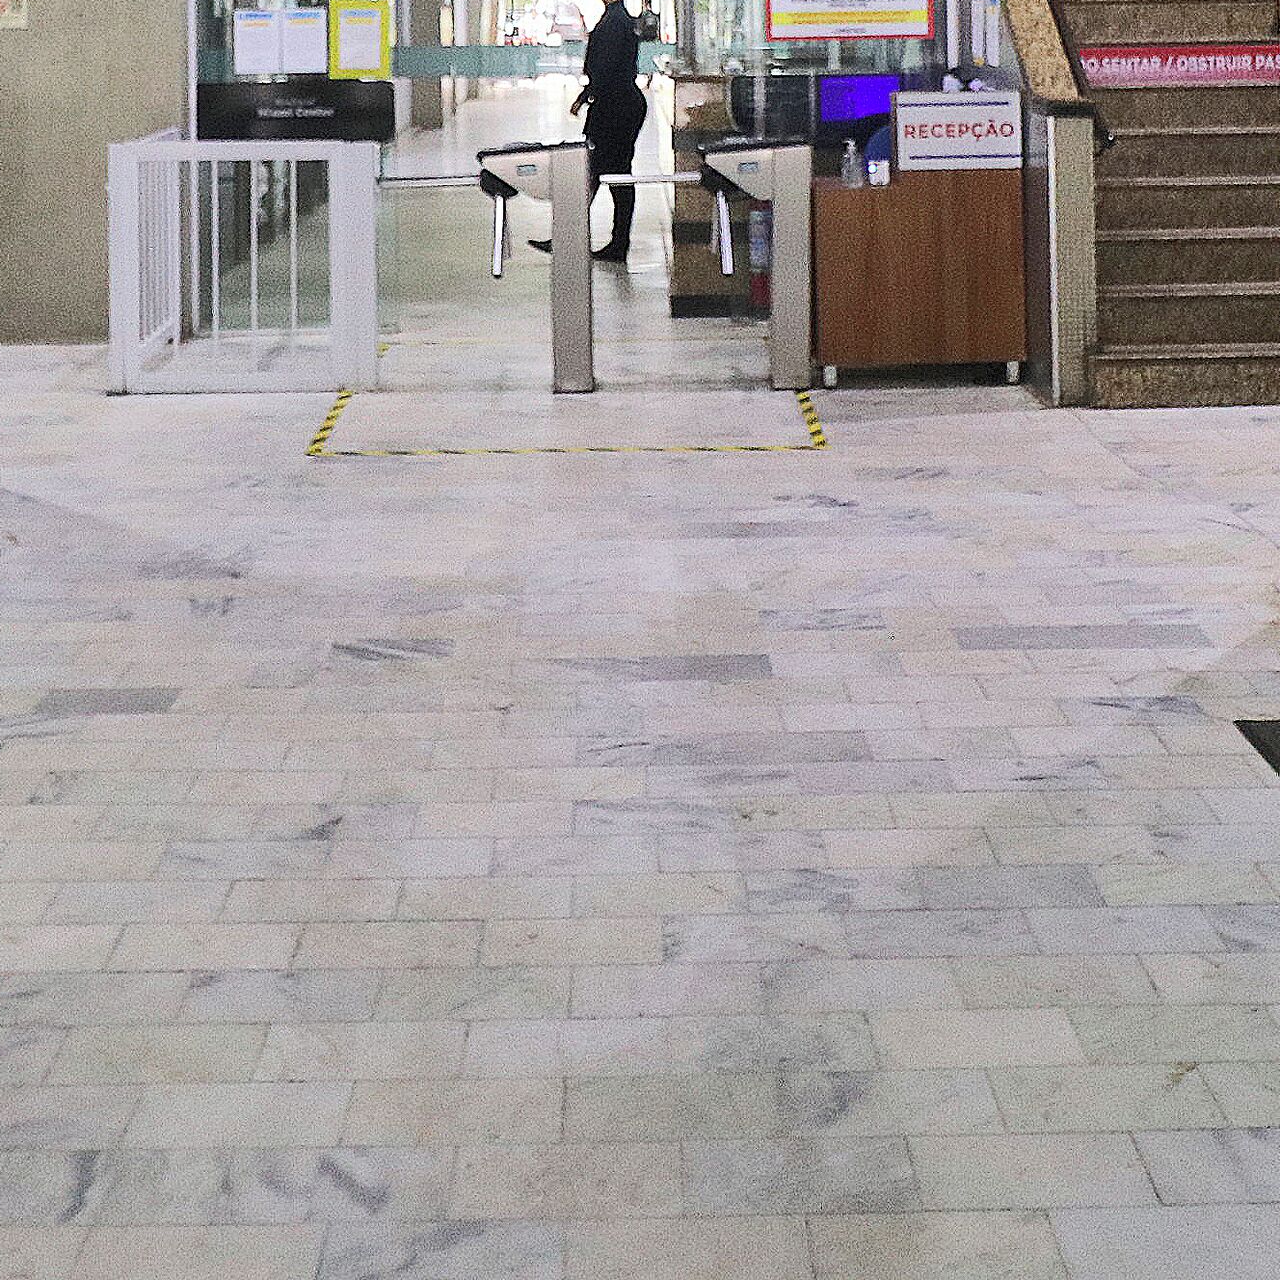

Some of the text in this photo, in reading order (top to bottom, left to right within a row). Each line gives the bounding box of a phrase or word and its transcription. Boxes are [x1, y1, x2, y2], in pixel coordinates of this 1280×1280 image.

[1100, 56, 1164, 71] SENTAR
[1176, 54, 1252, 71] OBSTRUIR
[903, 118, 1015, 142] RECEPÇÃO
